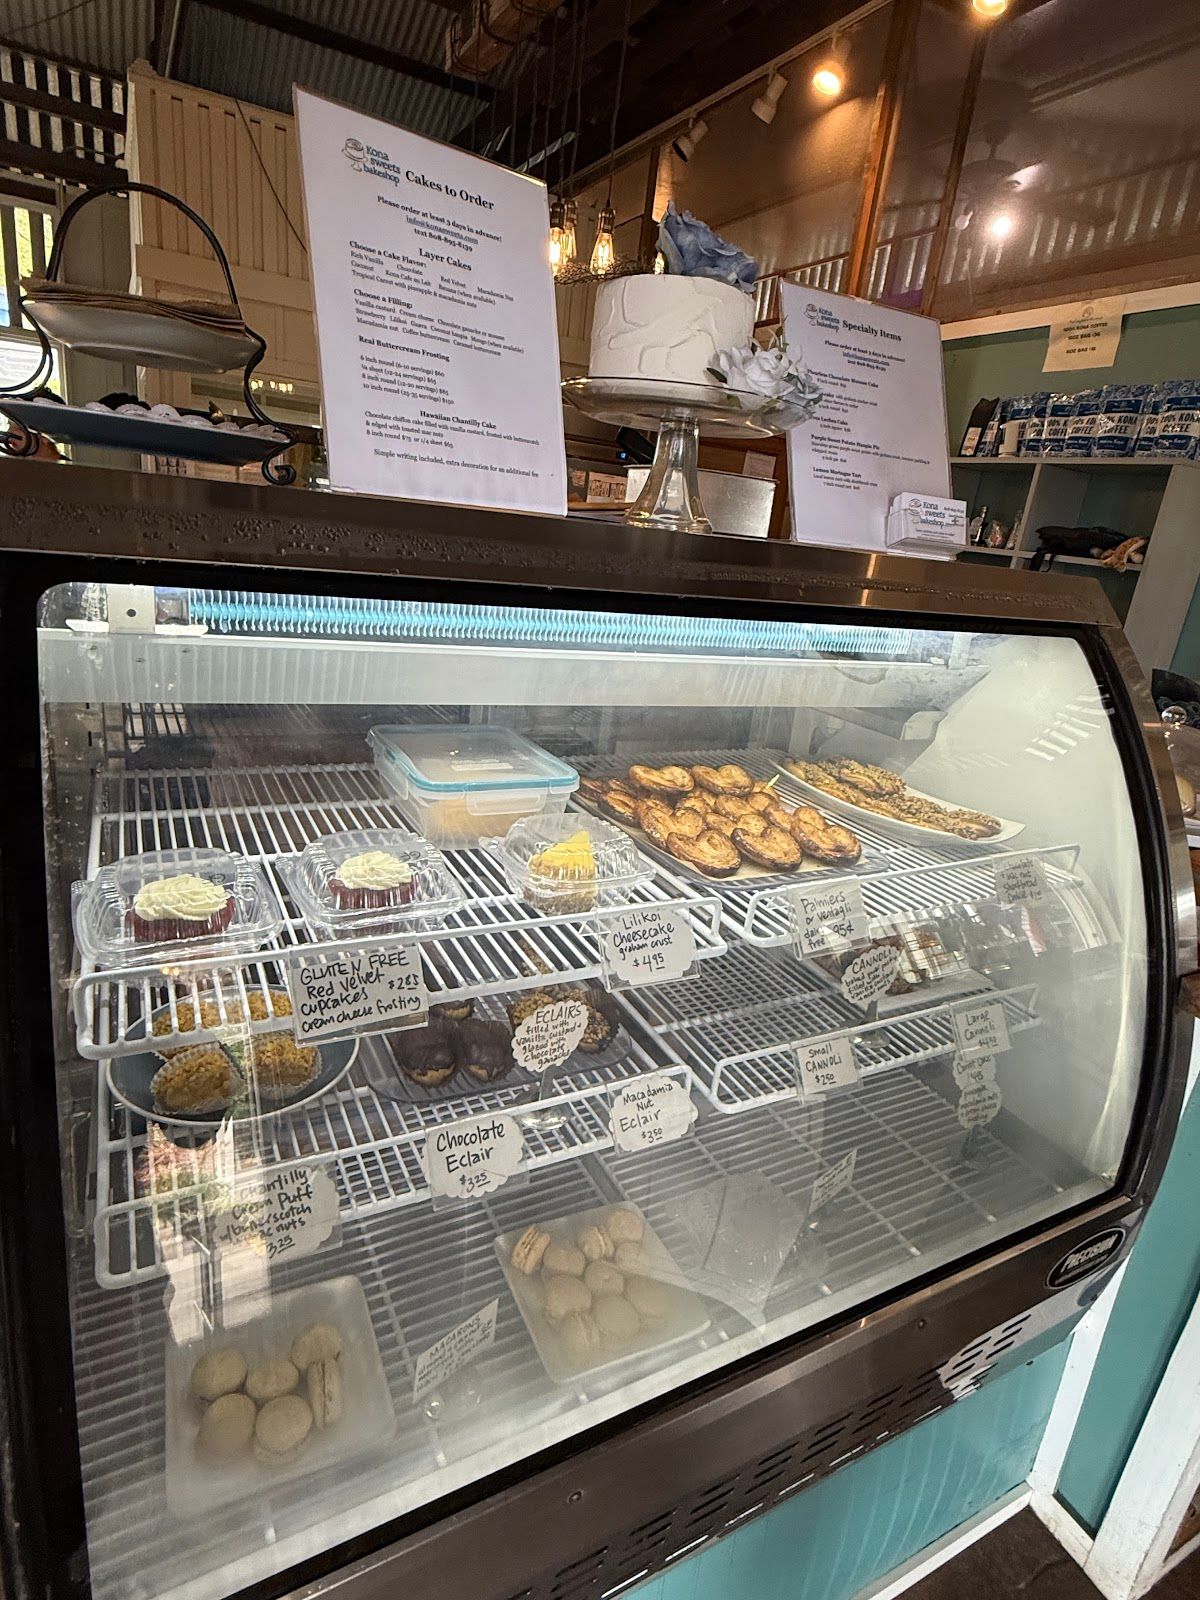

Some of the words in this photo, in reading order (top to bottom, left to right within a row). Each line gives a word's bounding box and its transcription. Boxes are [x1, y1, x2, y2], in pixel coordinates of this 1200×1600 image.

[366, 145, 390, 161] Kona
[363, 162, 400, 187] bakeshop
[370, 157, 400, 174] sweets
[406, 170, 442, 192] Cakes
[445, 184, 457, 197] to
[460, 189, 495, 210] Order
[377, 195, 400, 209] Please
[401, 205, 420, 216] order
[430, 212, 446, 224] least
[452, 220, 466, 231] days
[466, 224, 474, 234] in
[475, 228, 502, 242] advance!
[349, 240, 376, 254] Choose
[382, 250, 400, 260] Cake
[419, 248, 445, 262] Layer
[446, 256, 472, 271] Cakes
[354, 288, 380, 300] Choose
[842, 320, 879, 336] Specialty
[880, 329, 902, 342] Items
[358, 335, 375, 345] Real
[376, 339, 421, 354] Buttercream
[422, 349, 450, 362] Frosting
[364, 410, 392, 420] Chocolate
[420, 410, 450, 422] Hawaiian
[452, 416, 480, 428] Chantilly
[481, 421, 496, 430] Cake
[374, 448, 396, 458] Simple
[396, 452, 418, 462] writing
[922, 502, 938, 510] Kona
[622, 912, 662, 930] Lilikoi
[613, 922, 676, 948] Cheesecake
[618, 942, 649, 960] graham
[650, 936, 673, 948] crust
[300, 958, 362, 986] GLUTEN
[368, 950, 410, 970] FREE
[852, 948, 892, 974] CANNOLI
[306, 984, 334, 1000] Red
[336, 1006, 374, 1023] cheese
[376, 996, 421, 1016] frosting
[536, 1004, 582, 1024] ECLAIRS
[526, 1024, 549, 1035] filled
[552, 1020, 570, 1030] with
[516, 1033, 546, 1046] vanilla
[522, 1040, 548, 1055] glazed
[524, 1042, 566, 1062] chocolate
[808, 1042, 832, 1059] Small
[623, 1084, 674, 1106] Macadamia
[636, 1100, 655, 1112] Nut
[620, 1109, 661, 1132] Eclair
[436, 1120, 506, 1152] Chocolate
[446, 1146, 494, 1174] Eclair
[276, 1218, 306, 1234] nuts
